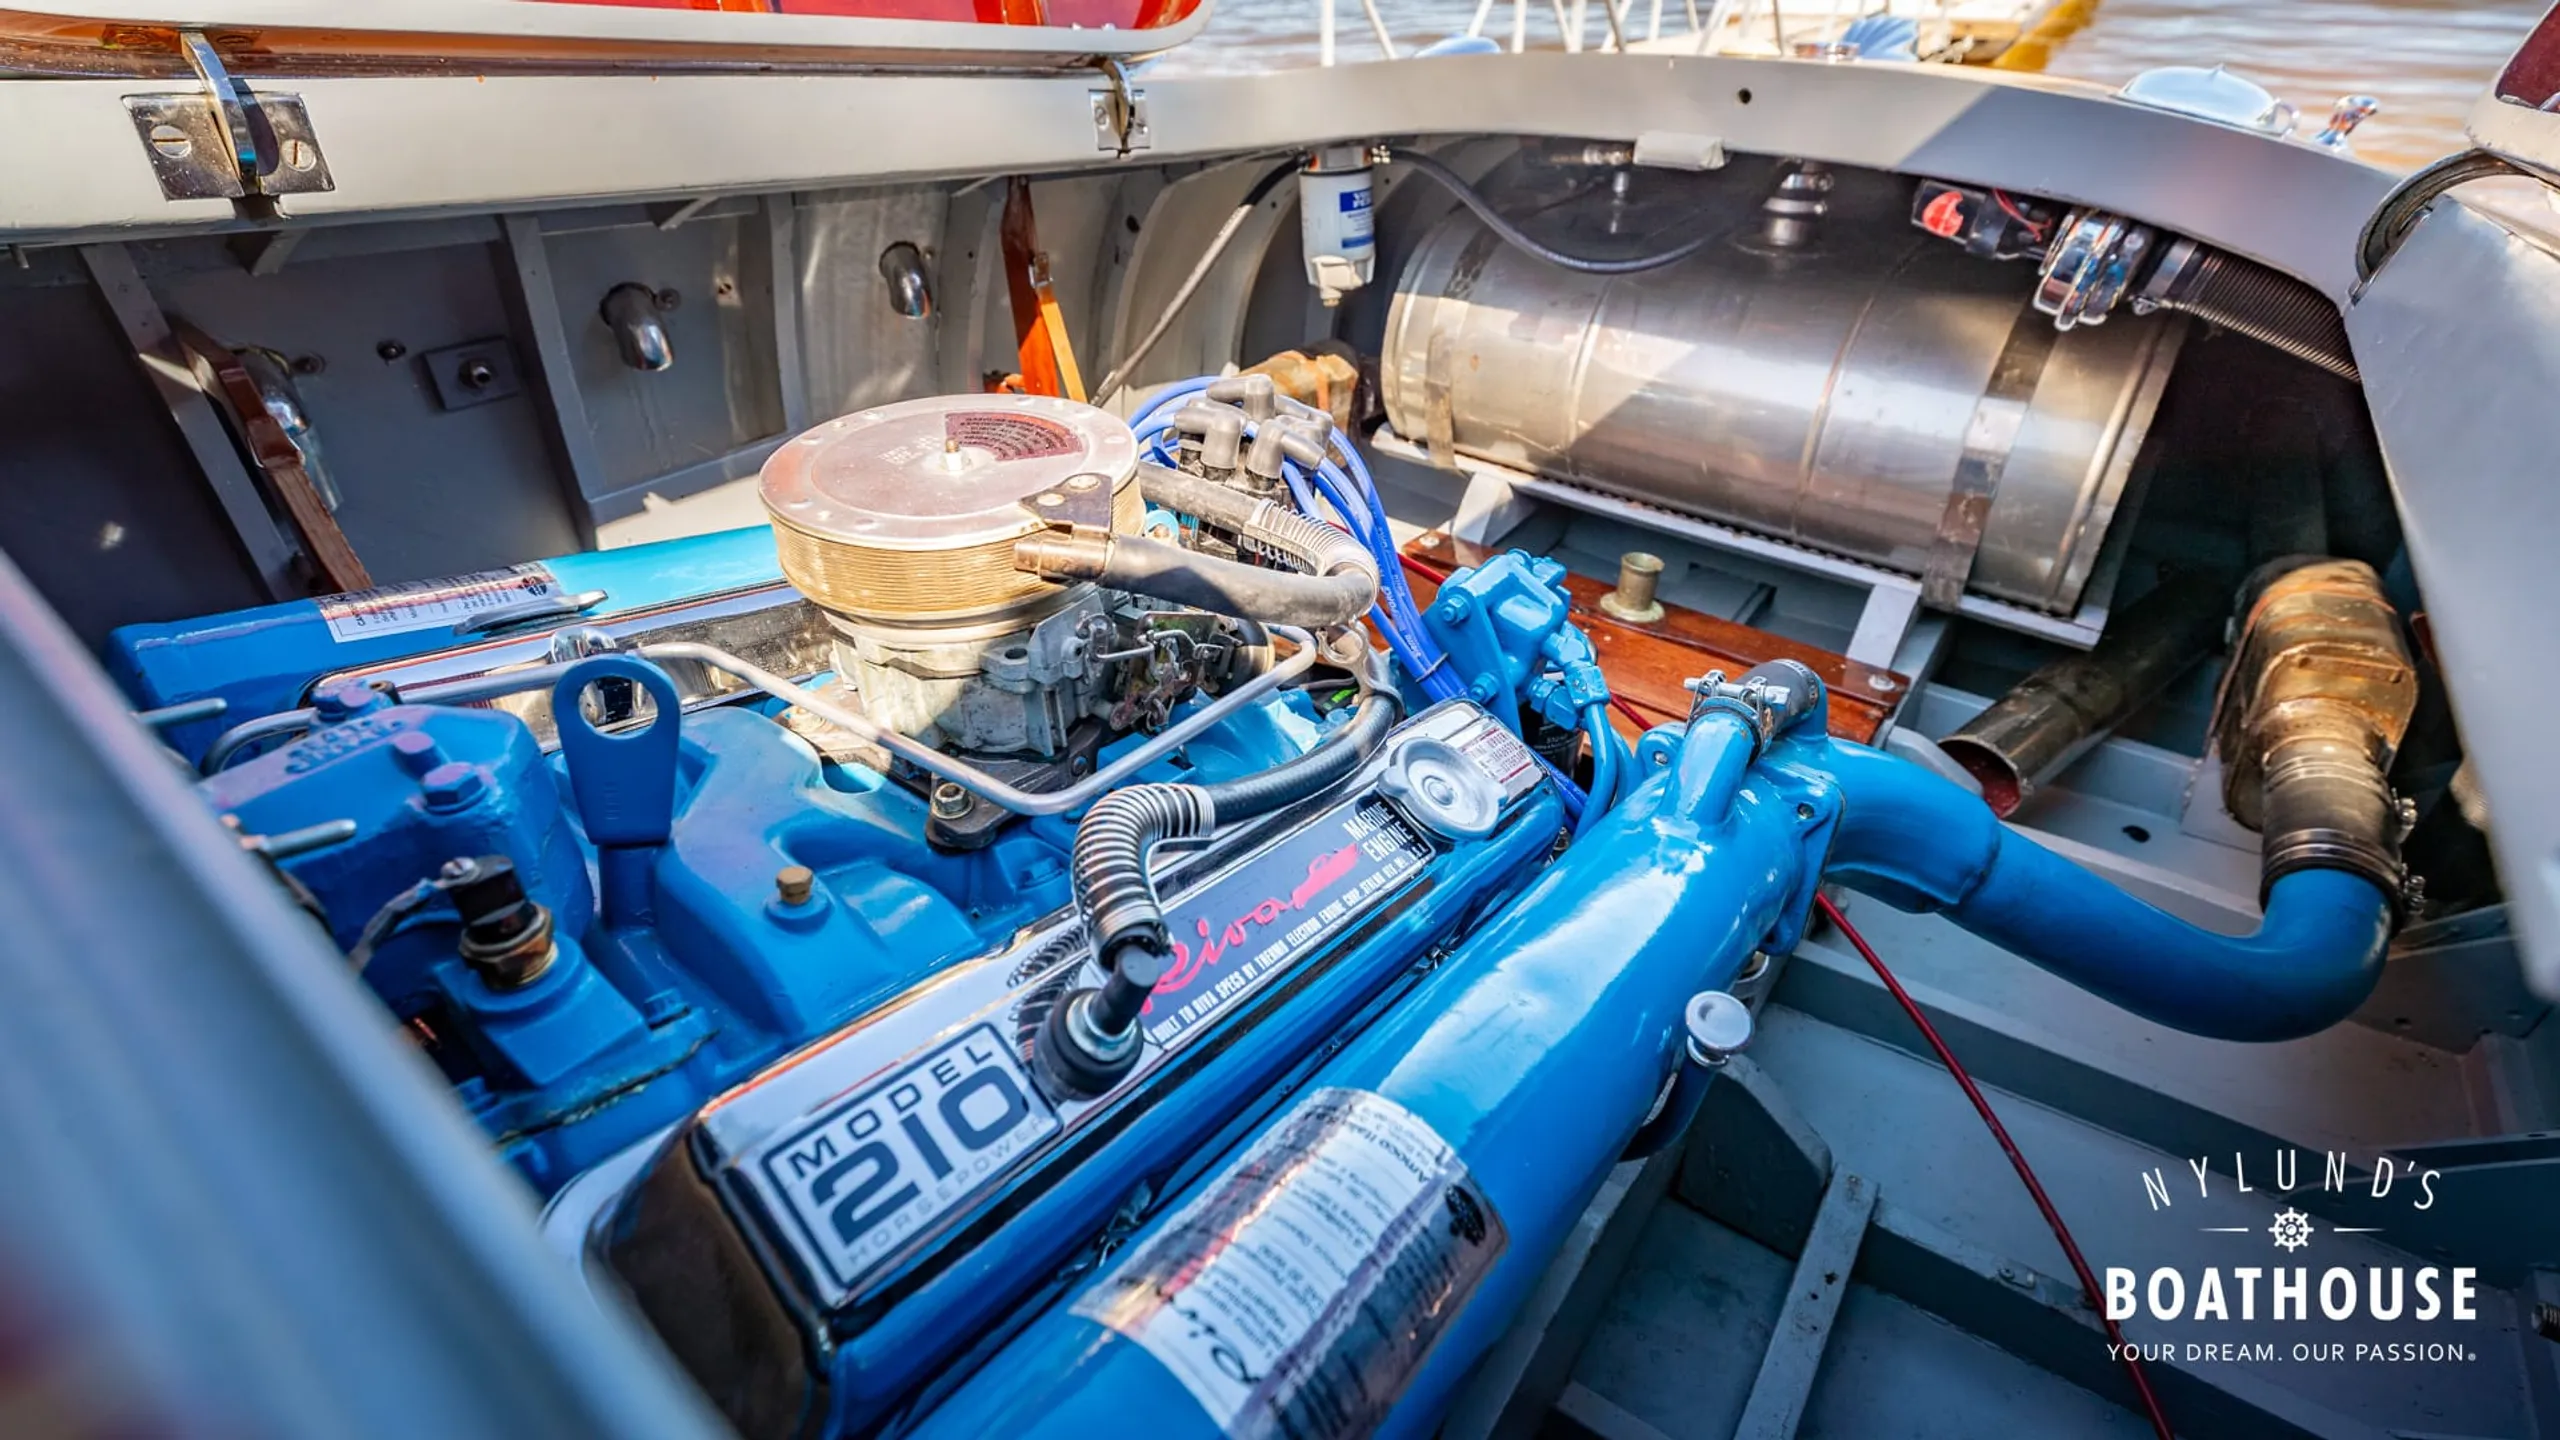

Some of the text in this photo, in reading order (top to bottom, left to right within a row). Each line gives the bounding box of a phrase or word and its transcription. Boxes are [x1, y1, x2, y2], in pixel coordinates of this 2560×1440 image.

[1342, 801, 1395, 841] MARINE
[1362, 821, 1414, 862] ENGINE
[1152, 1015, 1182, 1042] BUILT
[1178, 1005, 1197, 1024] TO
[1191, 990, 1219, 1015] RIVA
[1214, 970, 1247, 999] SPECS
[1242, 962, 1258, 980] BY
[788, 1045, 993, 1178] MODEL
[809, 1065, 1030, 1247] 210
[849, 1117, 1047, 1265] HORSEPOWER
